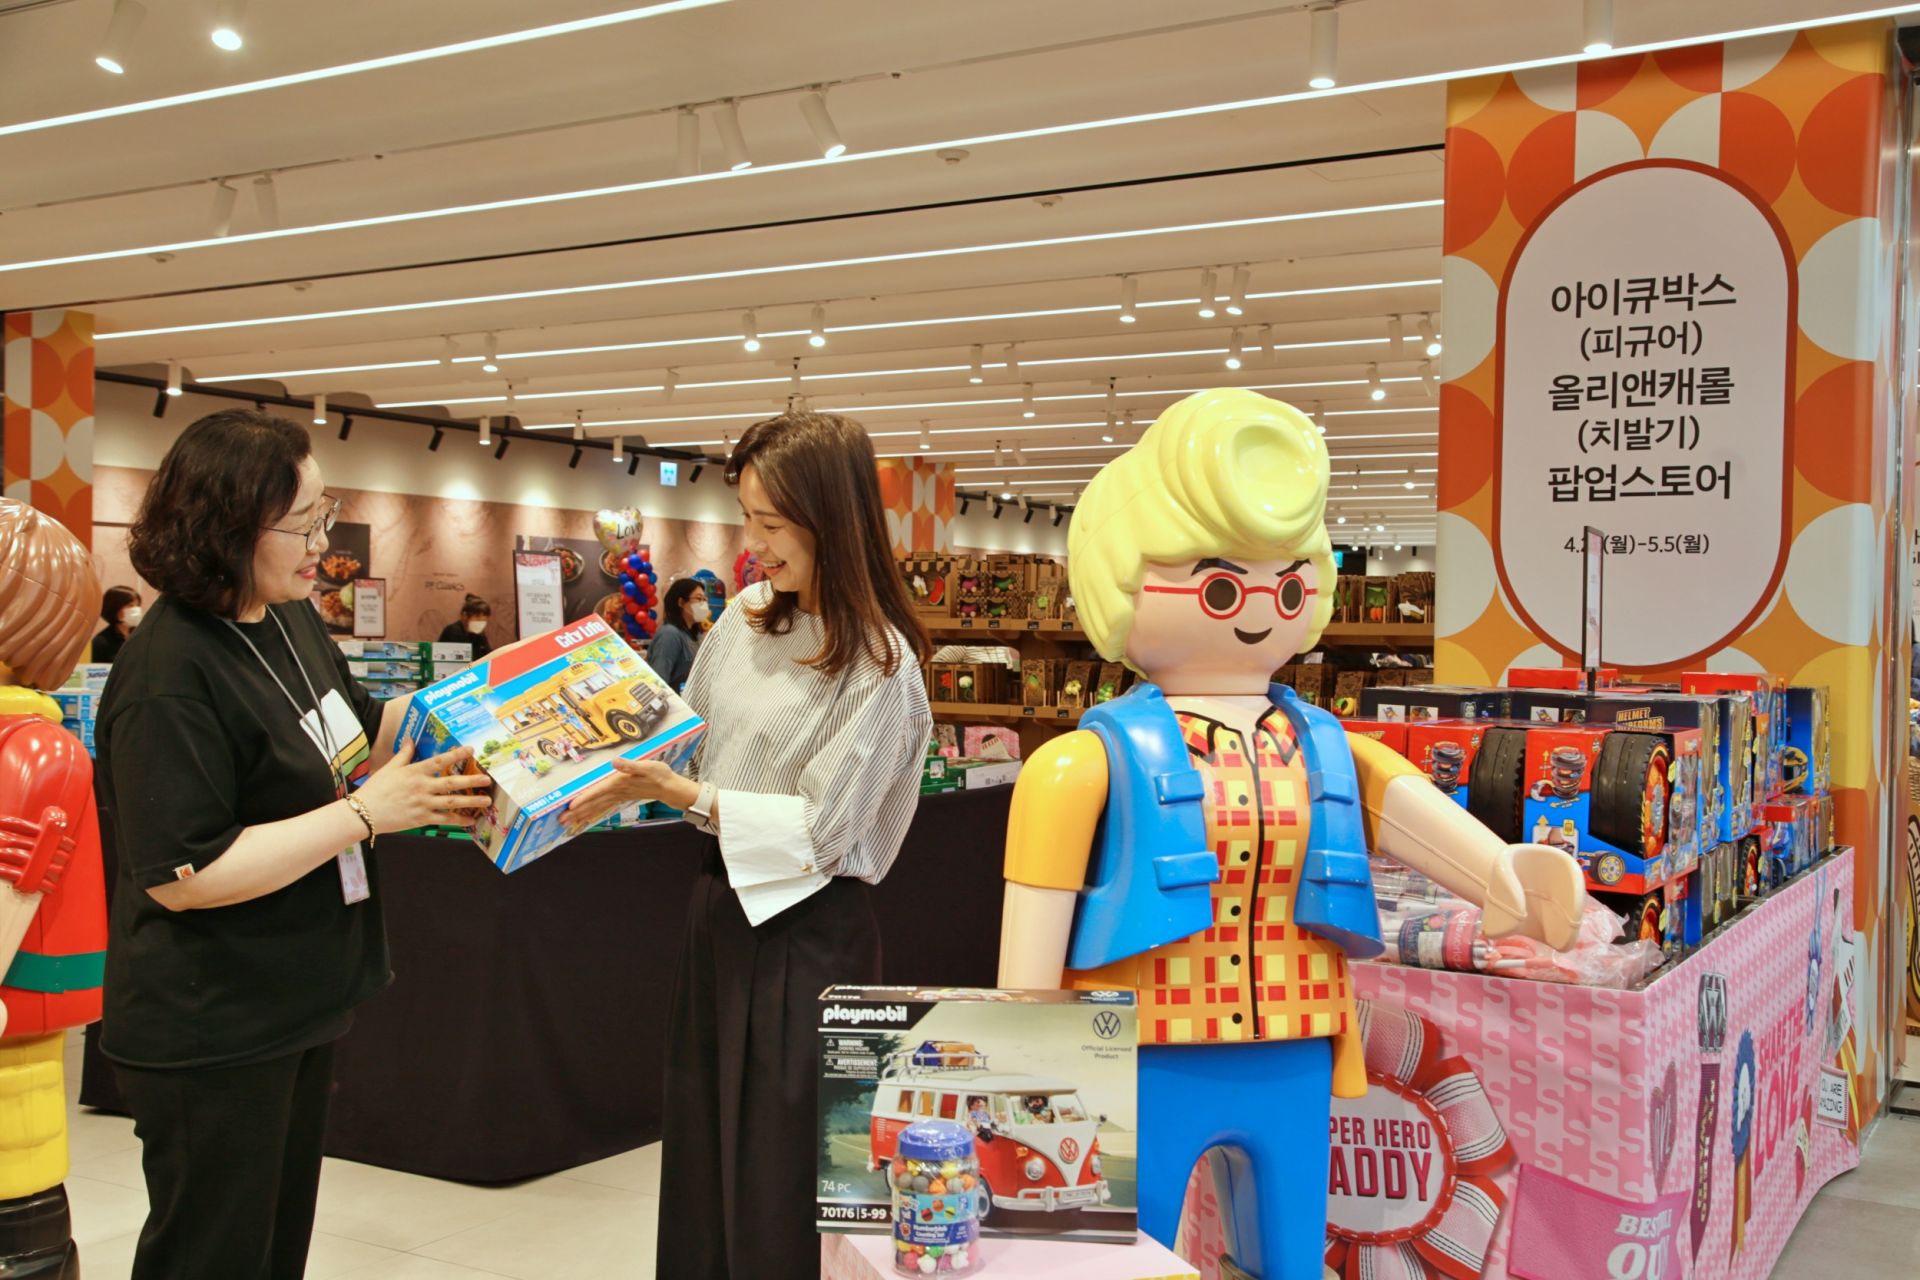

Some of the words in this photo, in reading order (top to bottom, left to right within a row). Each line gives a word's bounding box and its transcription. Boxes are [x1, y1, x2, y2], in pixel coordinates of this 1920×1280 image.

[1551, 272, 1737, 318] 아이큐박스
[1580, 321, 1703, 361] (피규어)
[1548, 366, 1735, 411] 올리앤캐롤
[1577, 416, 1700, 454] (치발기)
[1547, 460, 1733, 502] 팝업스토어
[1564, 534, 1709, 555] 4.(월)-5.5(월)
[554, 631, 584, 648] City
[577, 621, 605, 638] Life
[423, 672, 480, 706] playmobil
[1617, 708, 1650, 722] HELMET
[822, 1003, 908, 1025] playmobil
[1754, 1041, 1801, 1180] LOVE
[1328, 1115, 1366, 1146] PER
[1373, 1118, 1432, 1150] HERO
[821, 1179, 836, 1193] 74
[837, 1182, 852, 1193] PC
[1328, 1145, 1433, 1202] ADDY
